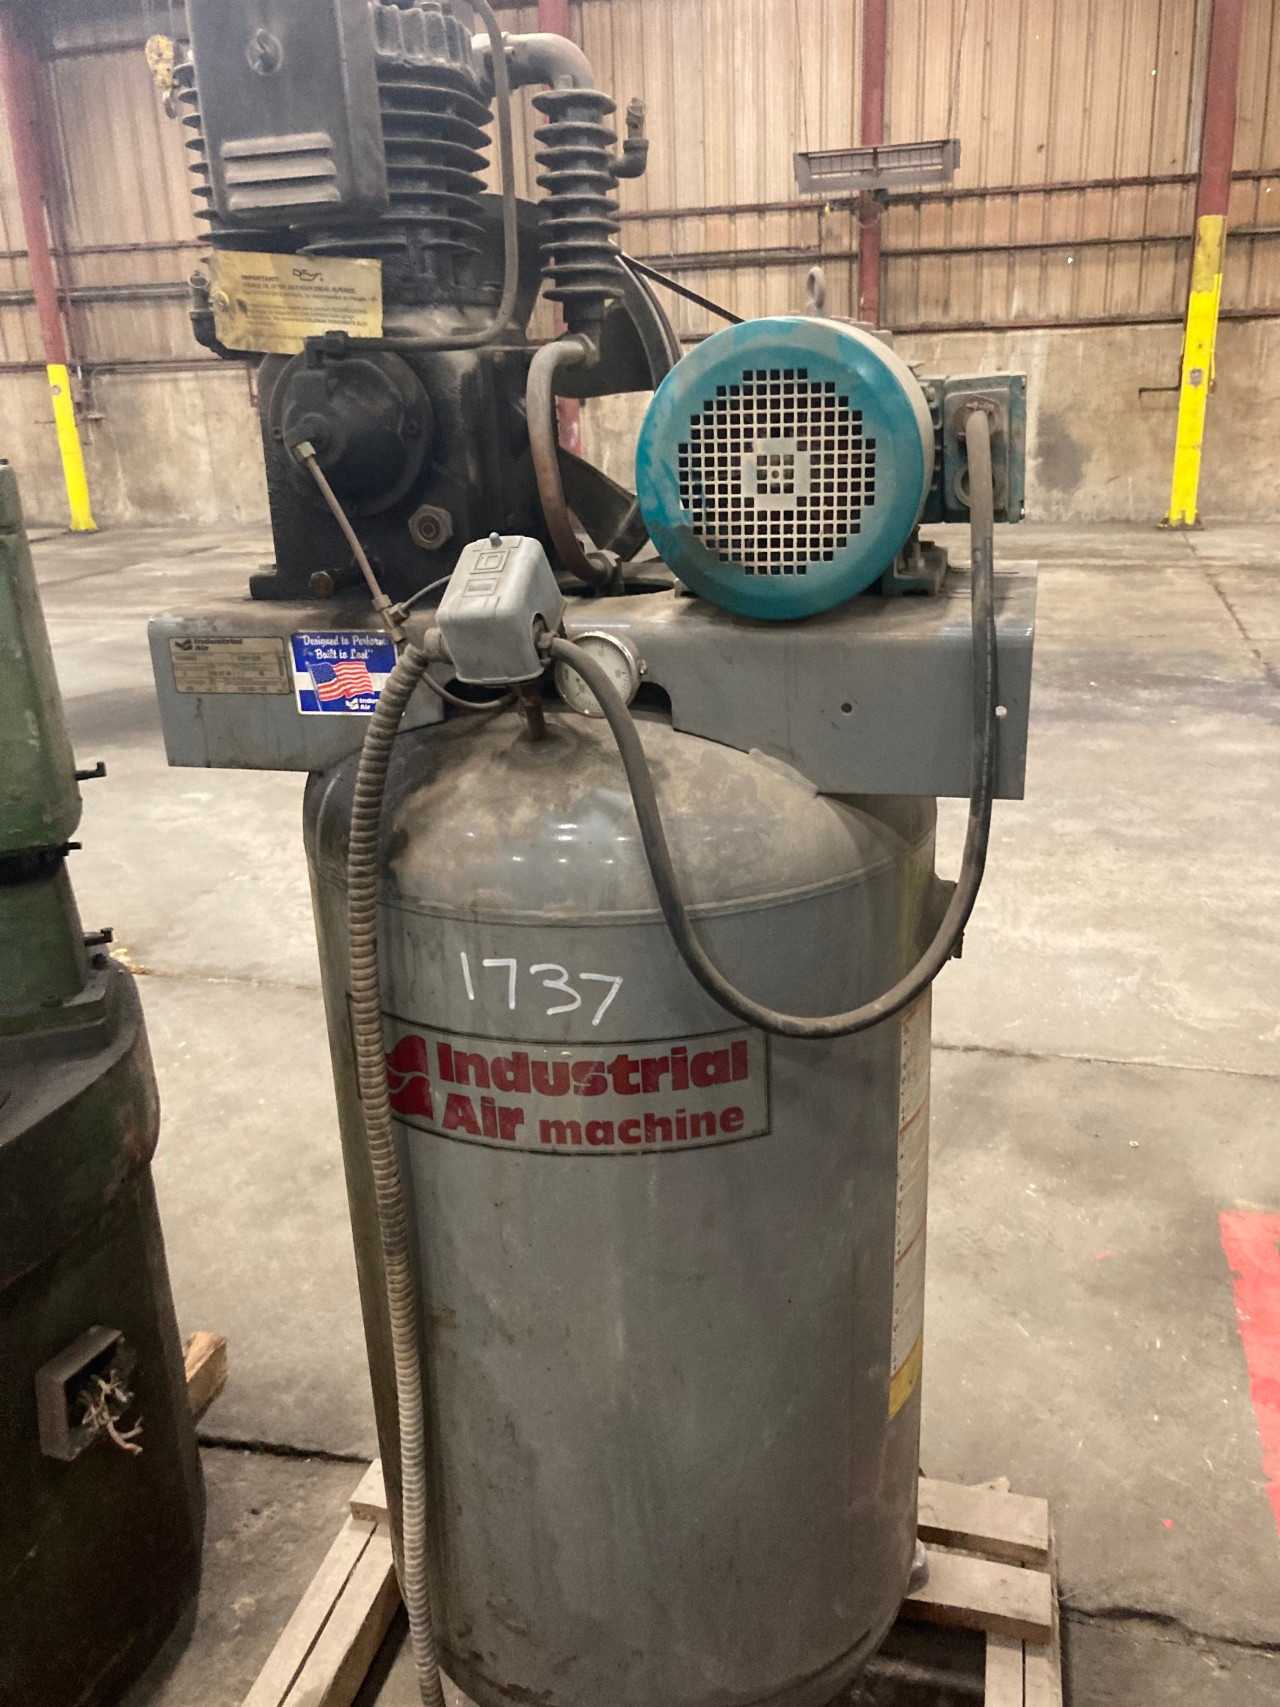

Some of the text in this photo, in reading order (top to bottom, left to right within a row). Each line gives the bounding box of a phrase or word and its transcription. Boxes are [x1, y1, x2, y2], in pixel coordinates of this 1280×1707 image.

[303, 635, 339, 647] Designed
[341, 636, 349, 646] to
[459, 951, 624, 1026] 1737
[436, 1040, 749, 1097] Industrial
[441, 1092, 745, 1146] Air machine
